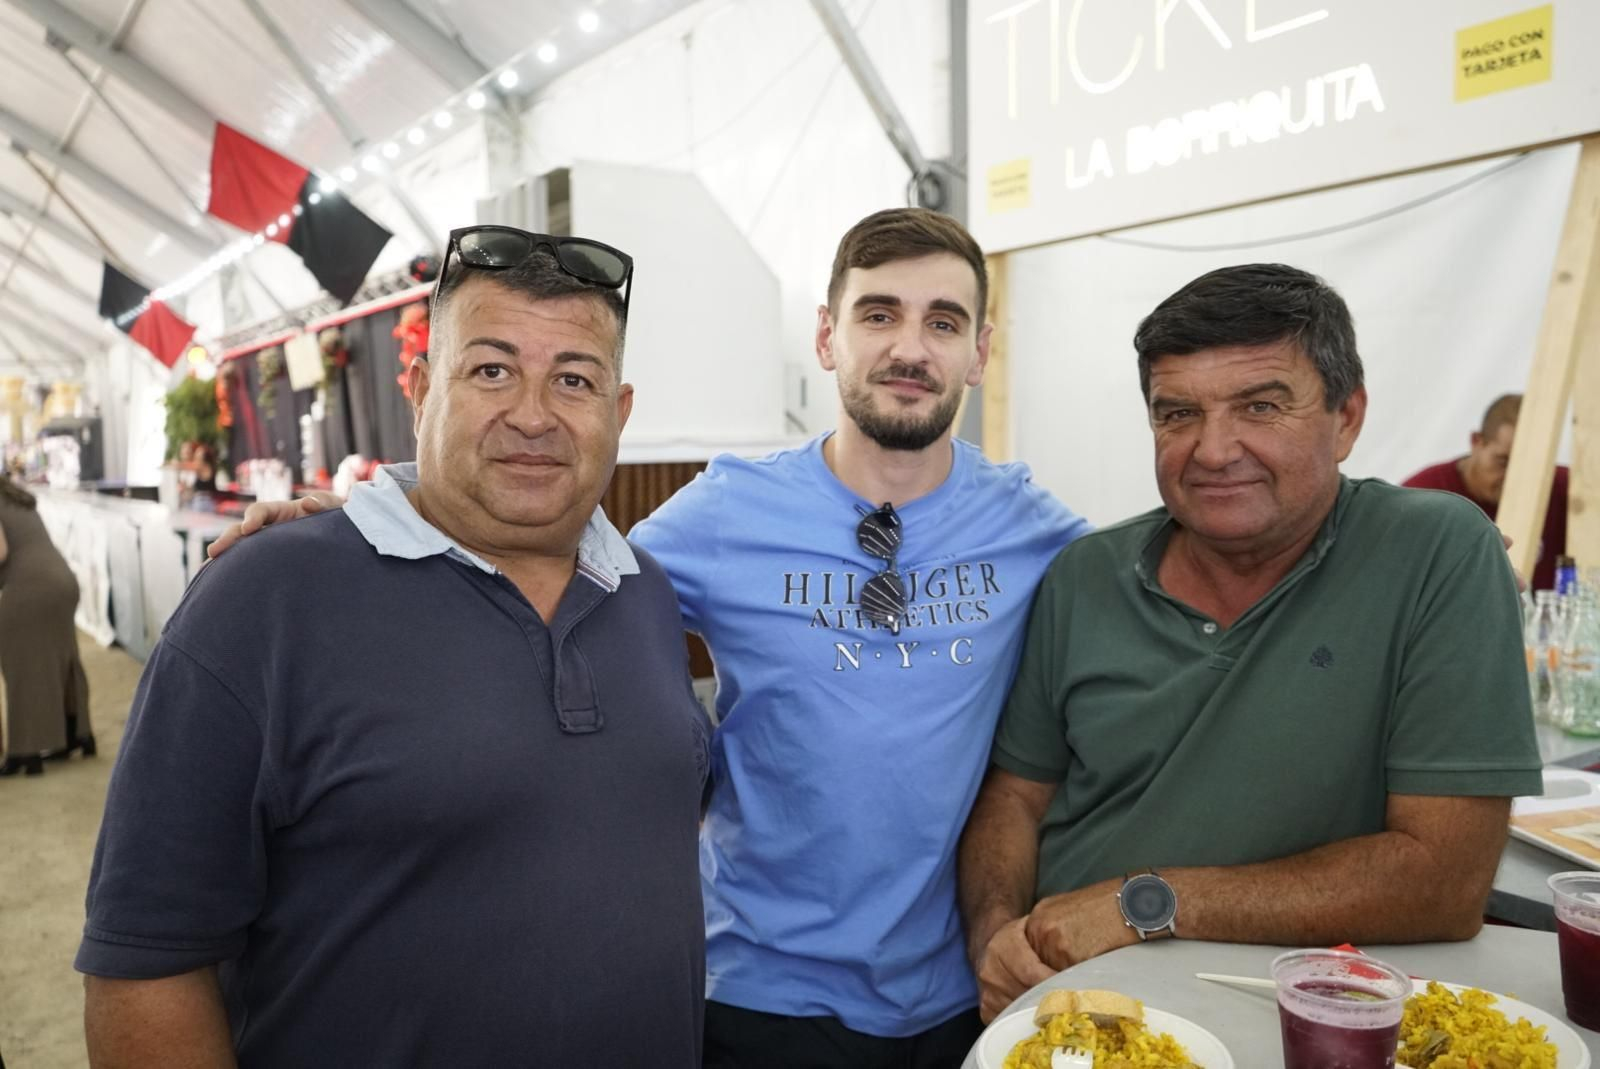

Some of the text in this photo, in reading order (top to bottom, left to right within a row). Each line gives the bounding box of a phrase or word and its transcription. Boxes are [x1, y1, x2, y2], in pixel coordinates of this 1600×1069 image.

[1508, 28, 1544, 48] CON
[1462, 47, 1543, 79] TARJETA
[1065, 137, 1114, 190] LA
